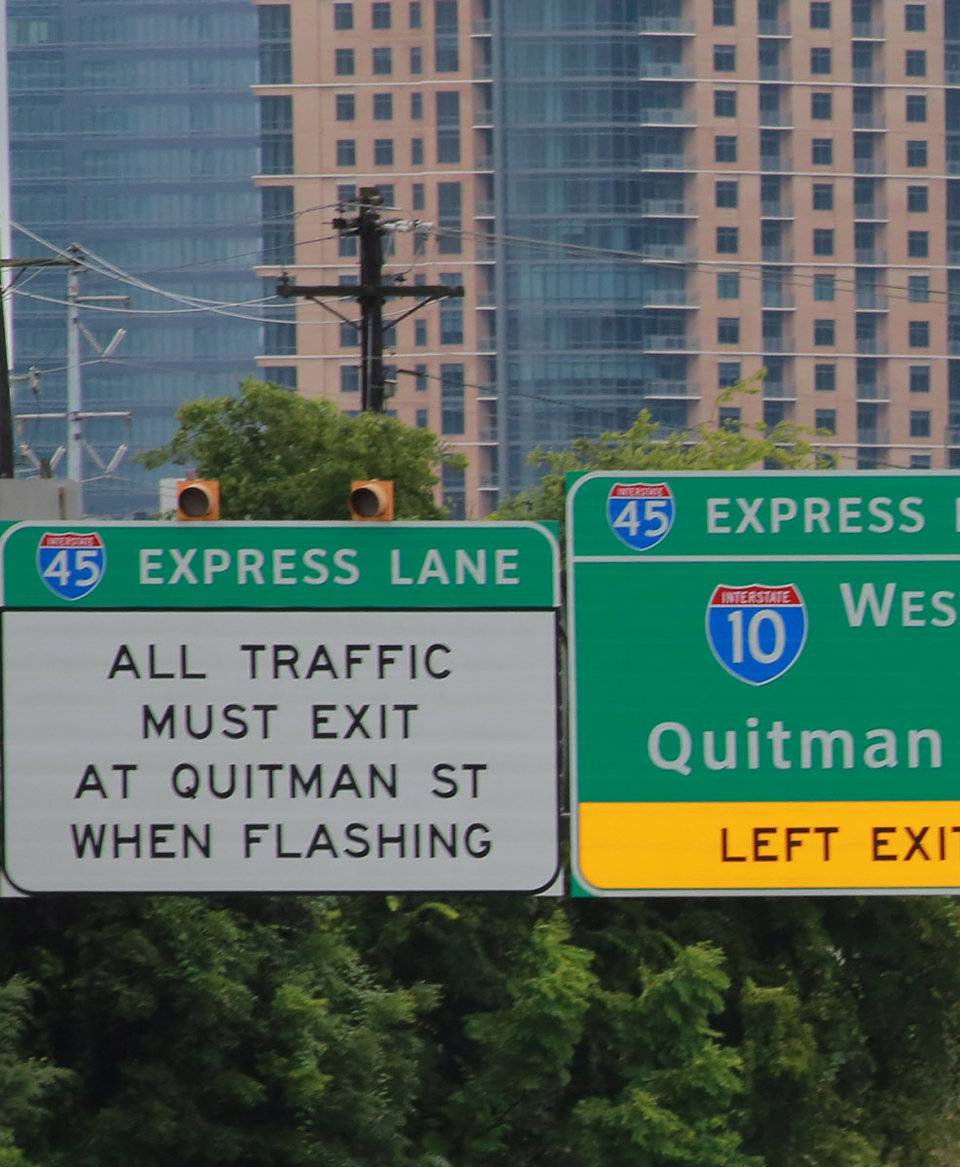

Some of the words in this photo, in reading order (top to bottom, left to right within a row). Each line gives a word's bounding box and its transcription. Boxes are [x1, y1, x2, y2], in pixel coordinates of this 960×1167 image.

[612, 500, 669, 537] 45
[707, 496, 925, 534] EXPRESS
[43, 549, 99, 588] 45
[140, 548, 360, 585] EXPRESS
[391, 549, 520, 585] LANE
[720, 590, 790, 604] INTERSTATE
[727, 608, 786, 665] 10
[107, 644, 207, 680] ALL
[240, 643, 452, 680] TRAFFIC
[142, 703, 278, 740] MUST
[312, 704, 419, 740] EXIT
[648, 717, 942, 776] Quitman
[74, 763, 139, 800] AT
[171, 762, 397, 800] QUITMAN
[431, 763, 488, 799] ST
[70, 823, 211, 859] WHEN
[244, 822, 492, 859] FLASHING
[723, 827, 838, 862] LEFT
